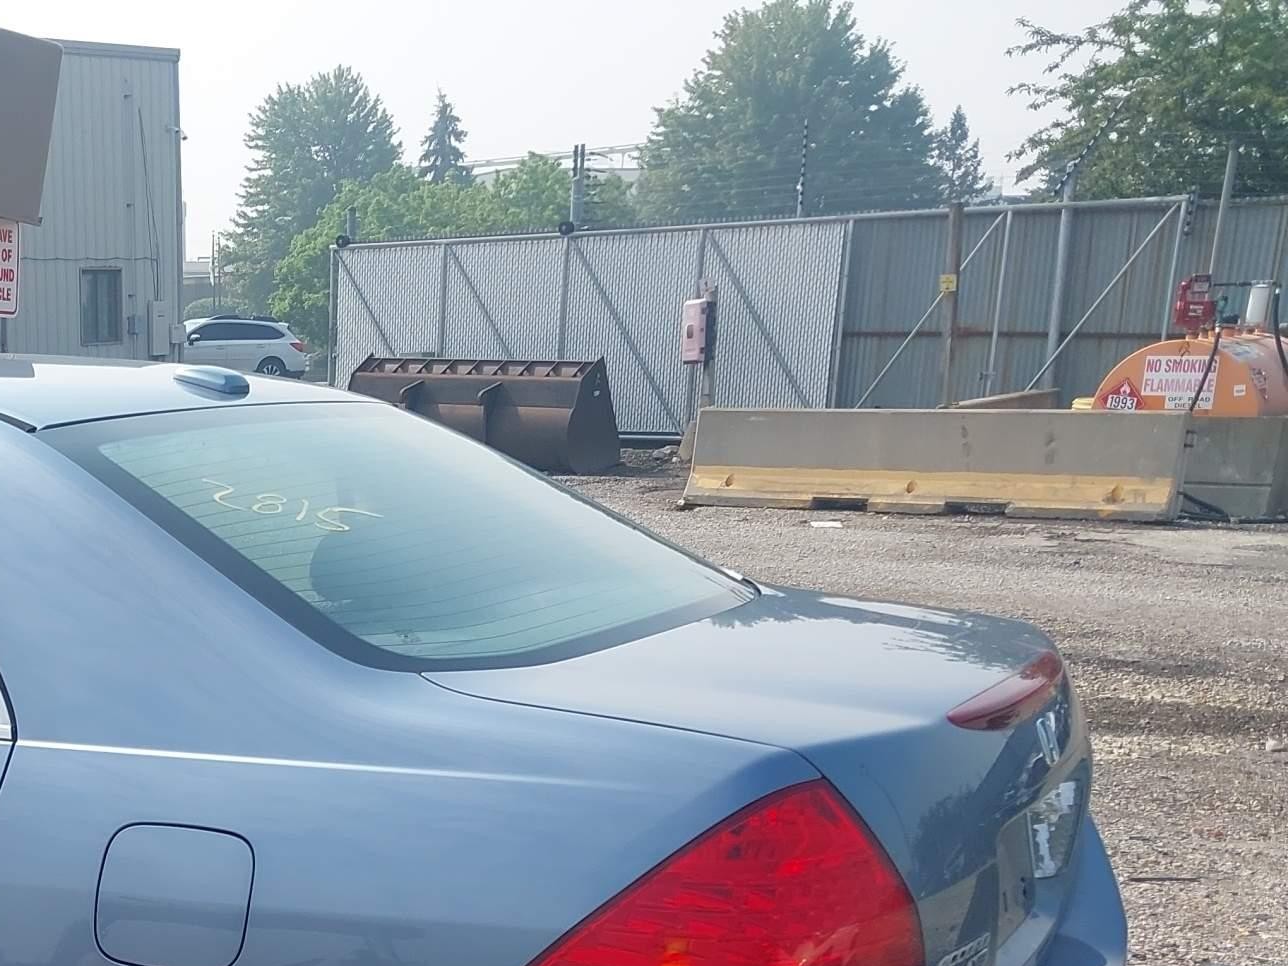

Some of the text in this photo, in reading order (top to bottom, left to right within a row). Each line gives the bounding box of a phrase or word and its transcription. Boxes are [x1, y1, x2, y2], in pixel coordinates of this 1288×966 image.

[1, 248, 13, 262] OF
[1146, 358, 1162, 373] NO
[1109, 396, 1135, 409] 1993
[201, 477, 384, 532] 2815
